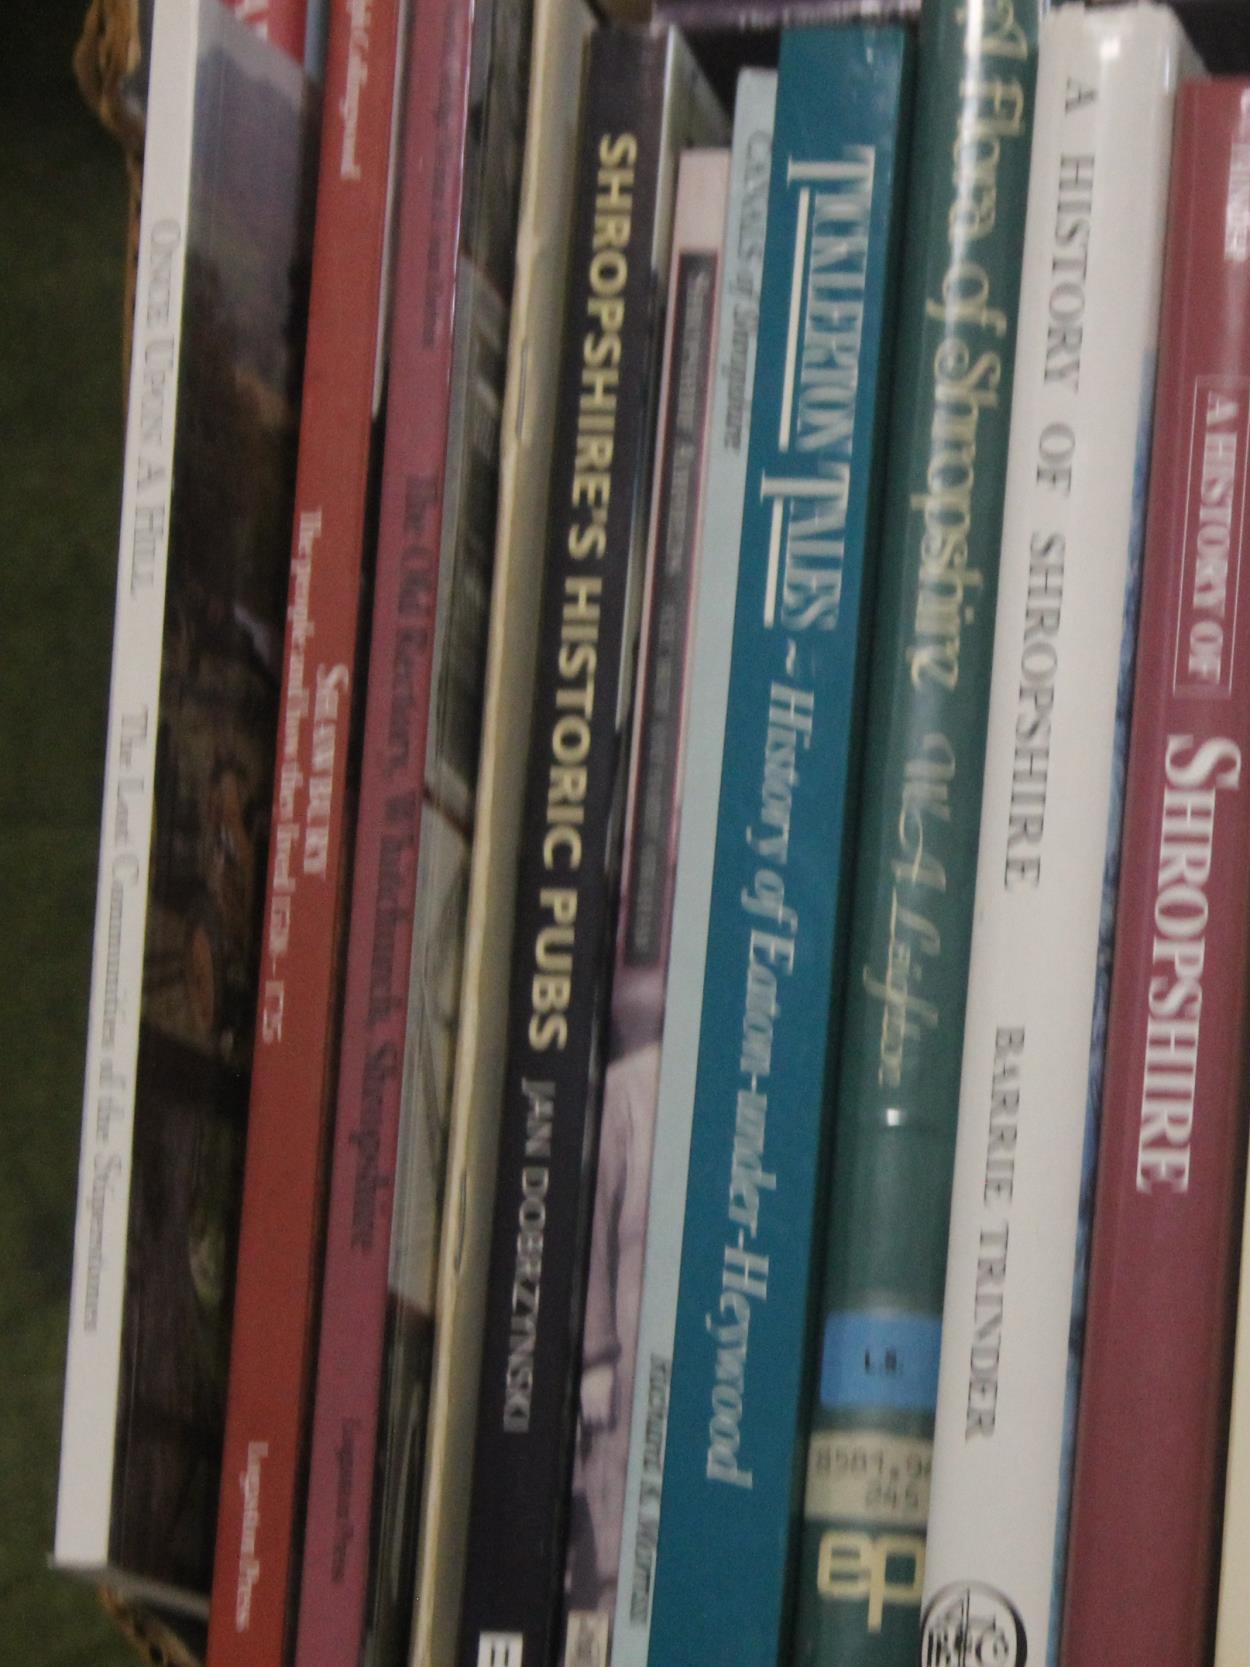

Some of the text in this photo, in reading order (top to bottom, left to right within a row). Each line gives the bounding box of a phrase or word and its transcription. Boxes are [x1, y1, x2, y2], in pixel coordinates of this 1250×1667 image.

[946, 80, 1027, 245] Flora
[771, 145, 878, 452] TICKLERTON
[923, 262, 1010, 340] of
[129, 504, 164, 598] HILL
[136, 458, 166, 494] A
[526, 133, 638, 1052] SHROPSHIRE'S HISTORIC PUBS
[756, 463, 851, 632] TALES
[904, 340, 1003, 692] Shropshire
[1002, 77, 1099, 893] A HISTORY OF SHROPSHIRE
[742, 683, 816, 866] History
[1133, 390, 1242, 1197] A HISTORY OF SHROPSHIRE
[737, 868, 802, 934] of
[500, 1077, 555, 1434] JAN DOBRZYNSKI
[963, 1025, 1025, 1442] BARRIE TRINDER
